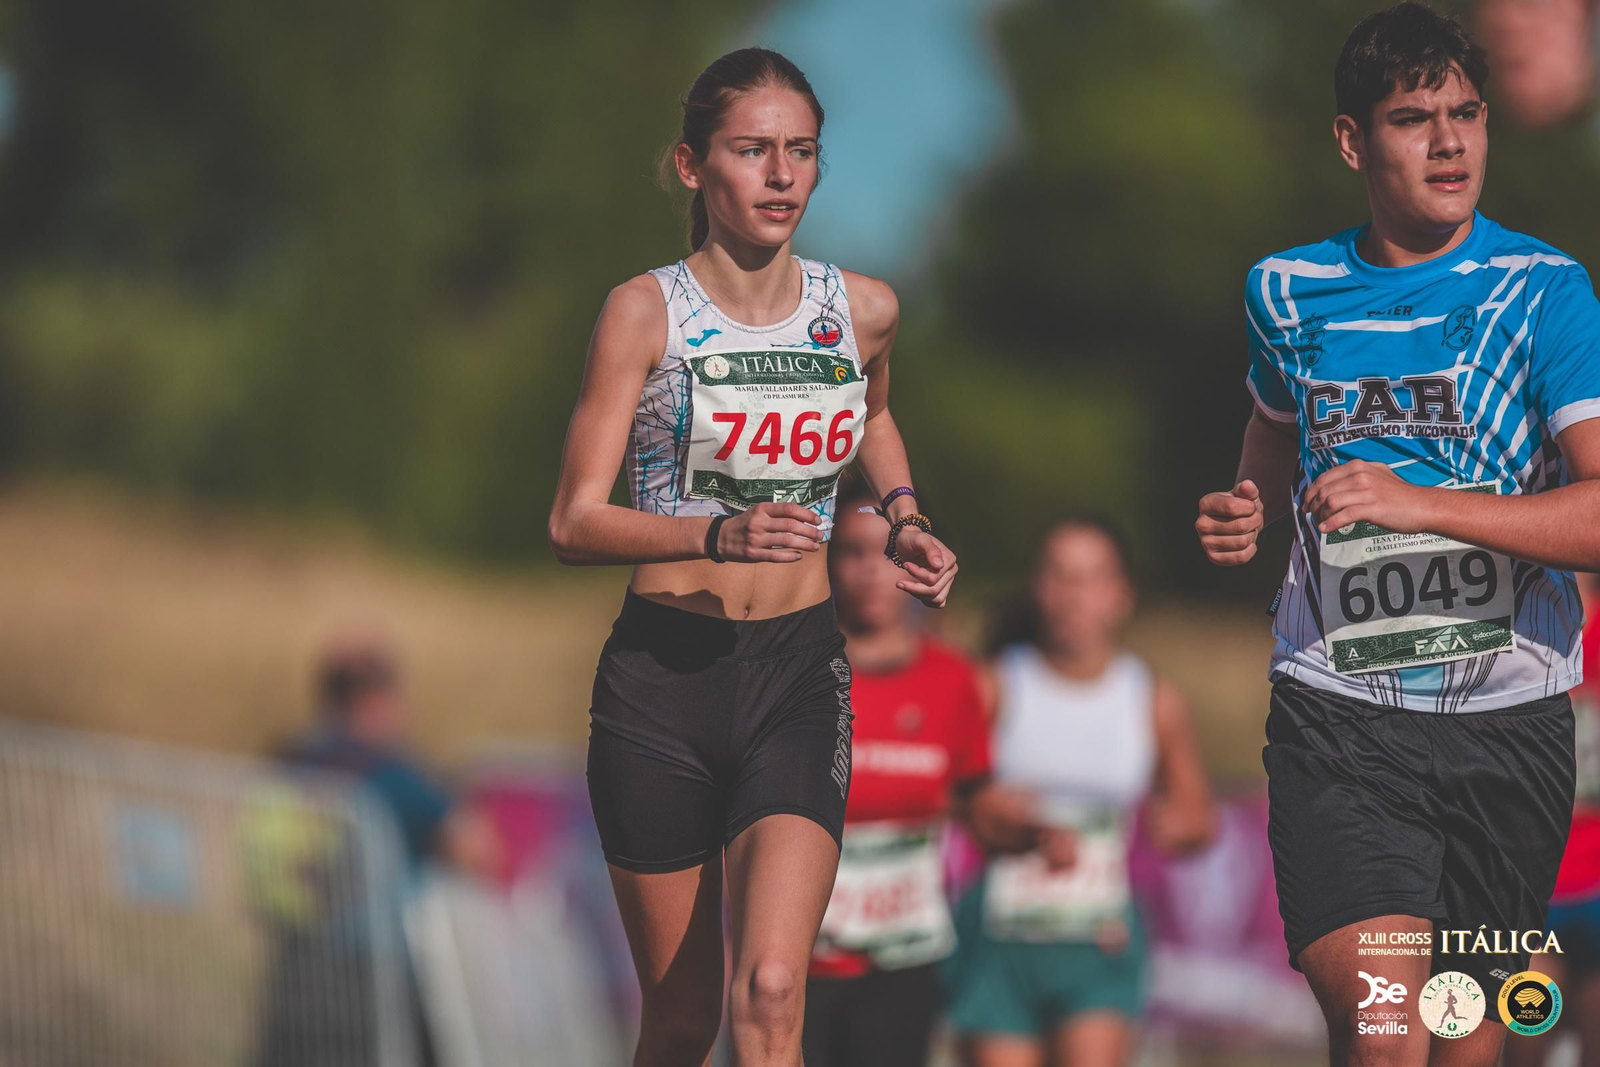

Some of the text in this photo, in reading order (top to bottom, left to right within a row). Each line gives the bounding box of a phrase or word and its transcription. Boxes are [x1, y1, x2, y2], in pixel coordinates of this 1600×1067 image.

[742, 352, 825, 373] ITÁLICA
[809, 384, 839, 392] SALADO
[1307, 375, 1463, 435] CAR
[712, 409, 854, 466] 7466
[1327, 424, 1401, 446] ATLETISMO
[1405, 424, 1477, 439] RINCONADA
[1365, 545, 1382, 553] CLUB
[1382, 541, 1419, 551] ATLETISMO
[1372, 535, 1391, 545] TENA
[1339, 550, 1498, 623] 6049
[1402, 656, 1433, 665] ANDALUZA
[1444, 650, 1475, 659] ATLETISMO
